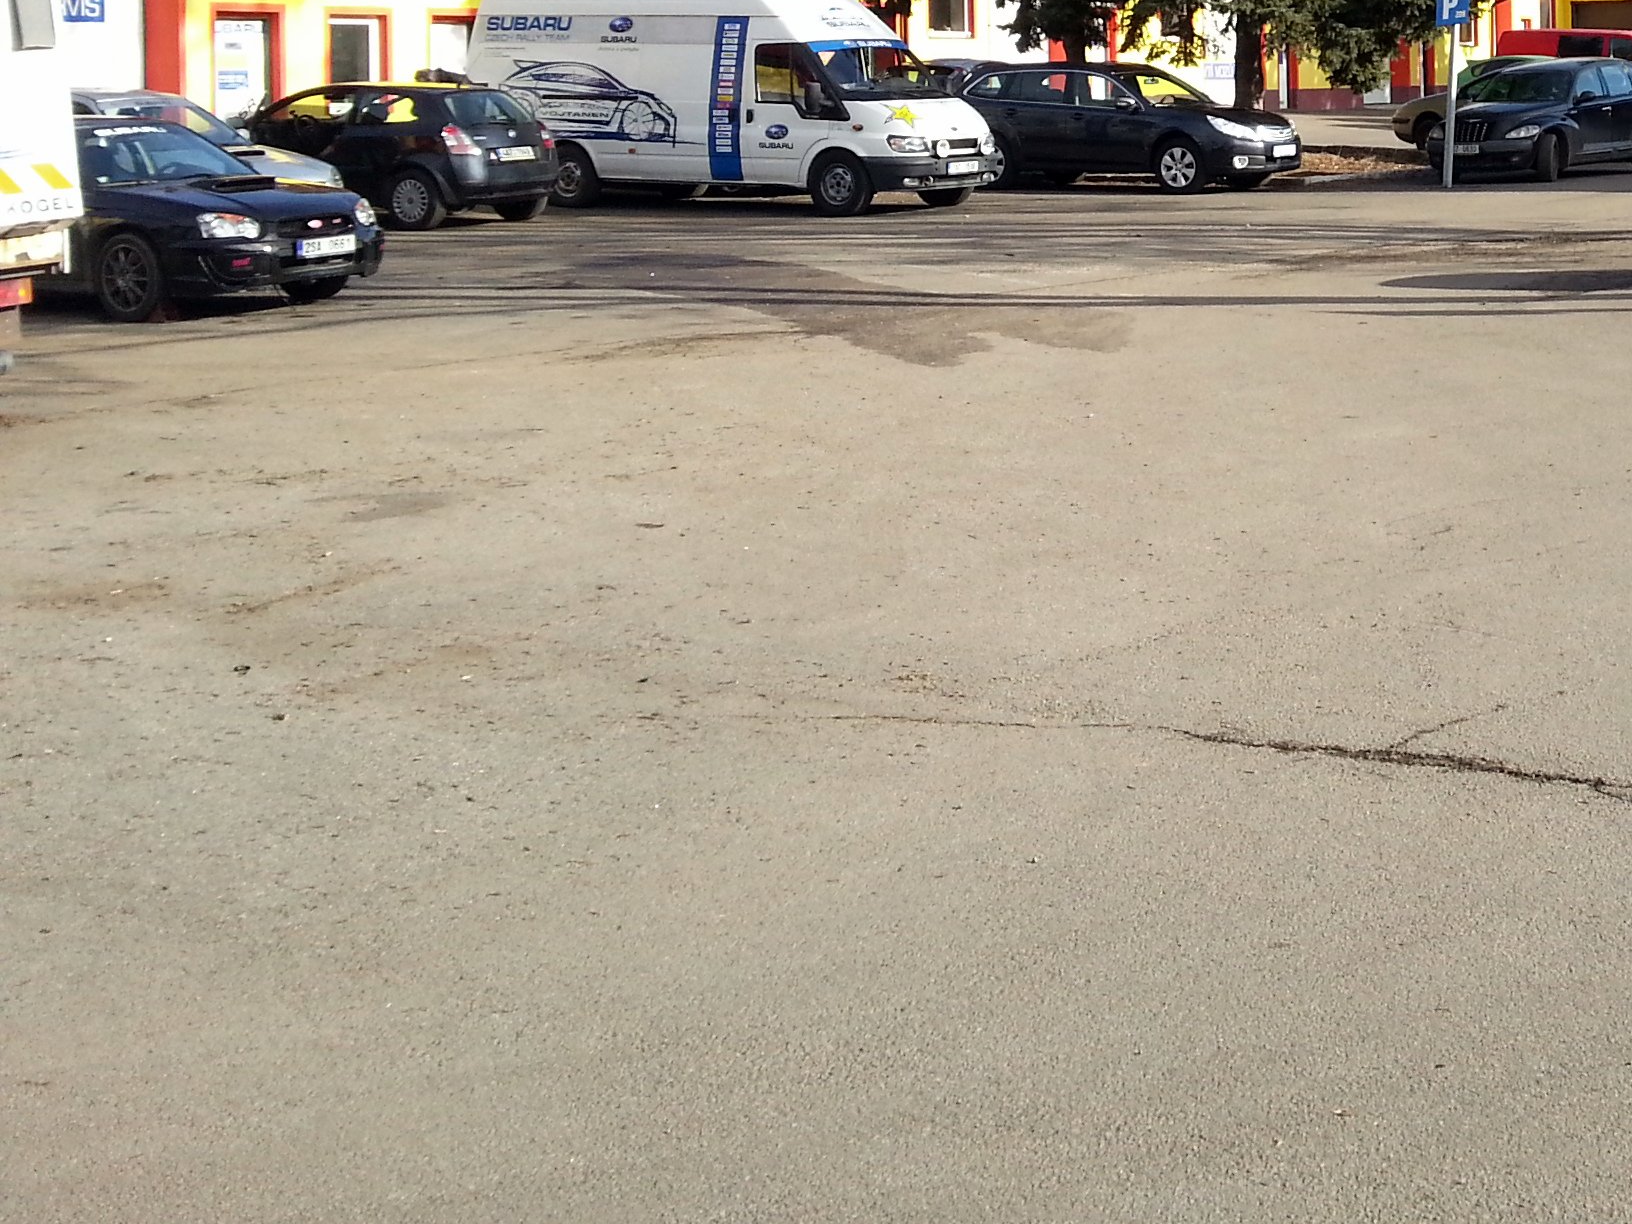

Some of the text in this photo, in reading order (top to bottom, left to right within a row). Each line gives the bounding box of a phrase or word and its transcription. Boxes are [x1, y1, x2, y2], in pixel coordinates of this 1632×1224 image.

[486, 16, 573, 31] SUBARU
[485, 33, 571, 43] CZECH RALLY TEAM
[600, 35, 638, 44] SUBARU
[758, 142, 794, 150] SUBARU
